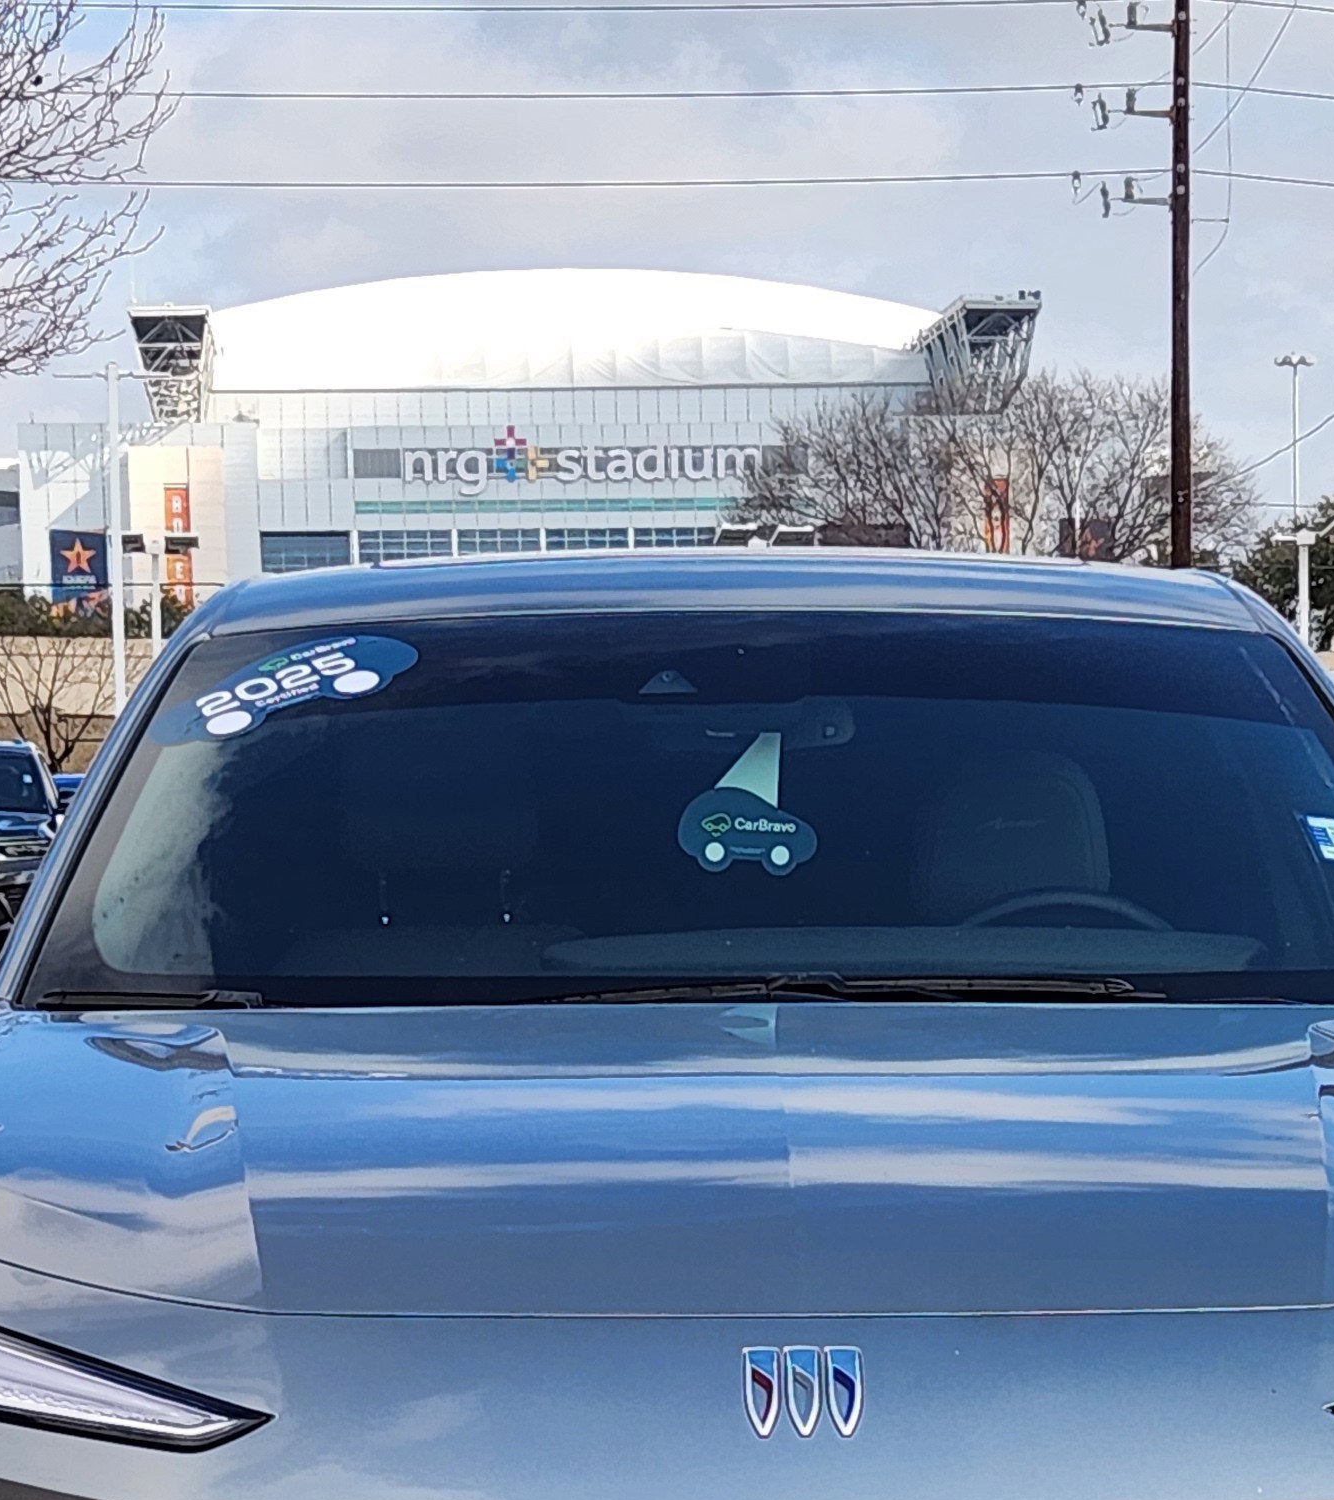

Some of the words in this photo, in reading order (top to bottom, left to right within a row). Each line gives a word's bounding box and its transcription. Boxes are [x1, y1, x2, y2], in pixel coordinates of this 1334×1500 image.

[404, 449, 487, 495] nrg
[556, 443, 761, 481] stadium
[196, 652, 356, 717] 2025
[734, 817, 796, 833] CarBravo
